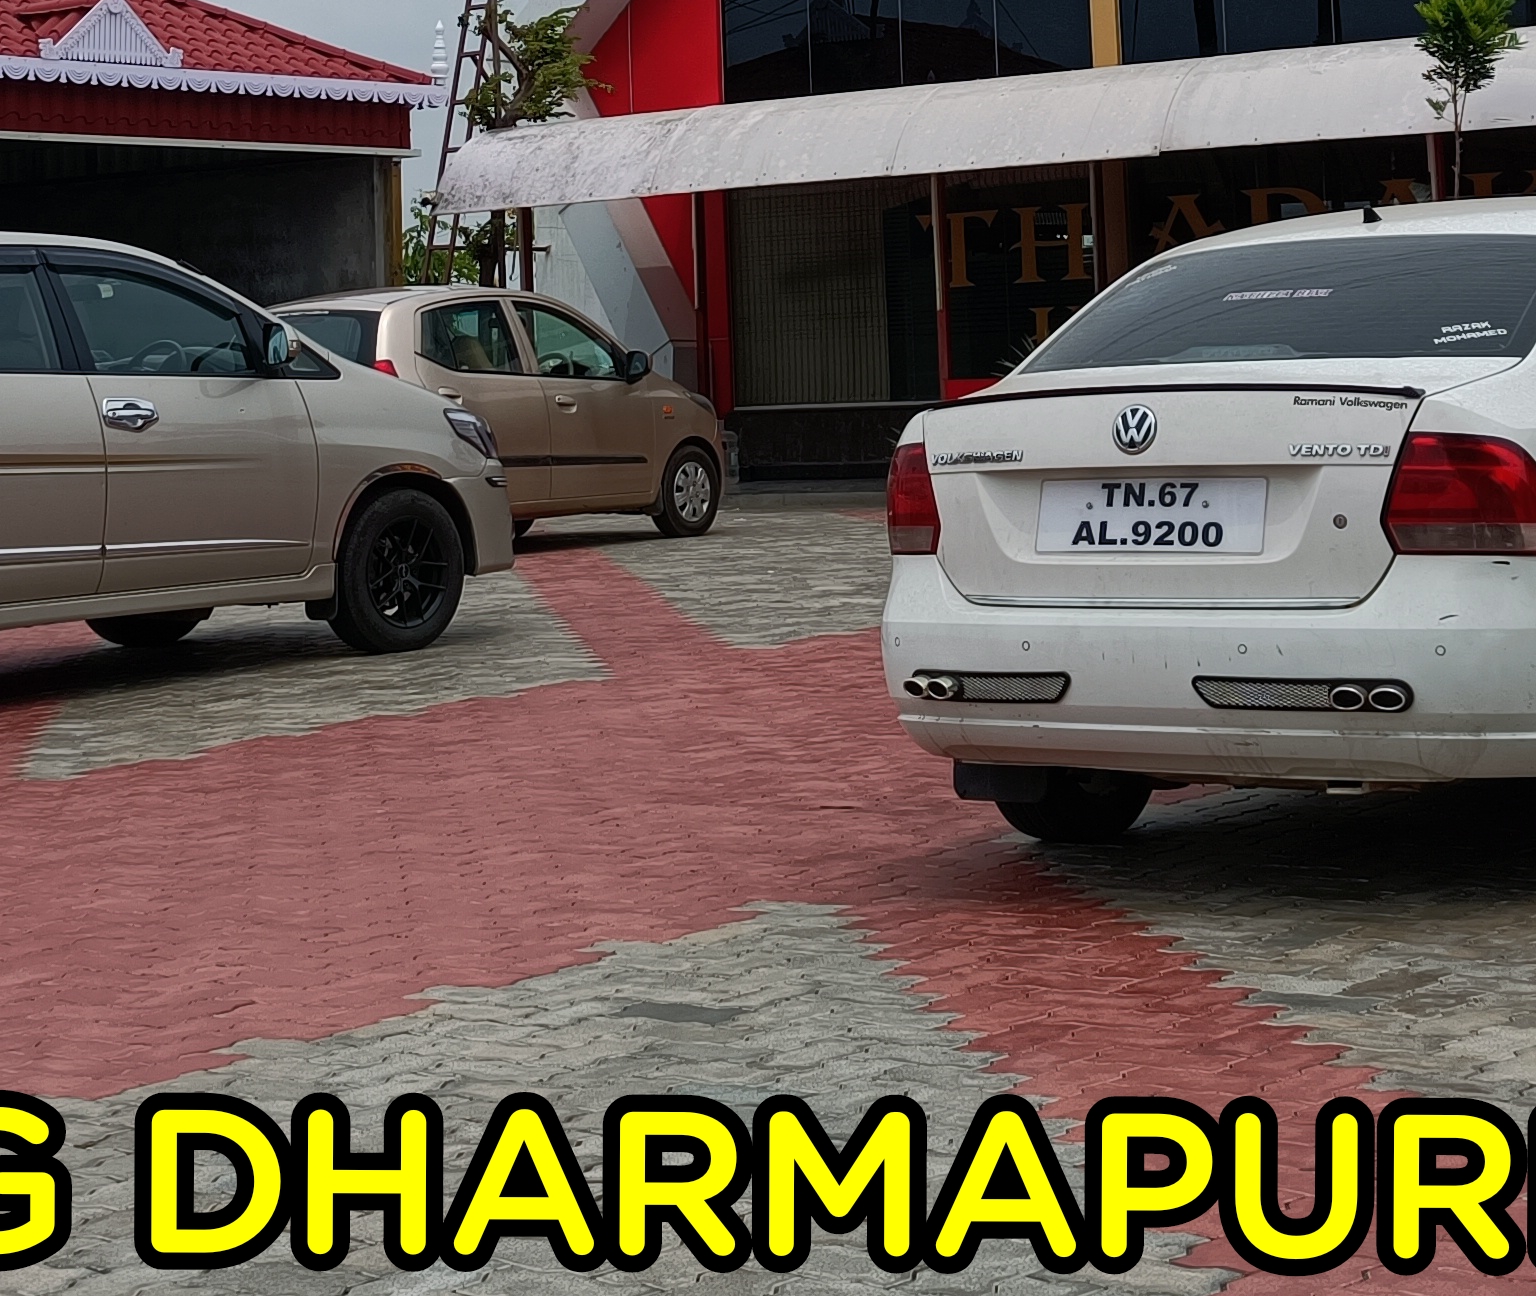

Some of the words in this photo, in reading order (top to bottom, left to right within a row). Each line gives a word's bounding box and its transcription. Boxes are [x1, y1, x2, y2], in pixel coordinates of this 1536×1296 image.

[1432, 328, 1508, 345] MOHAMED
[1293, 396, 1336, 406] Ramani
[1339, 396, 1408, 411] Volkswagen
[1288, 444, 1353, 457] VENTO
[1100, 481, 1200, 508] TN.67
[1070, 519, 1224, 548] AL.9200
